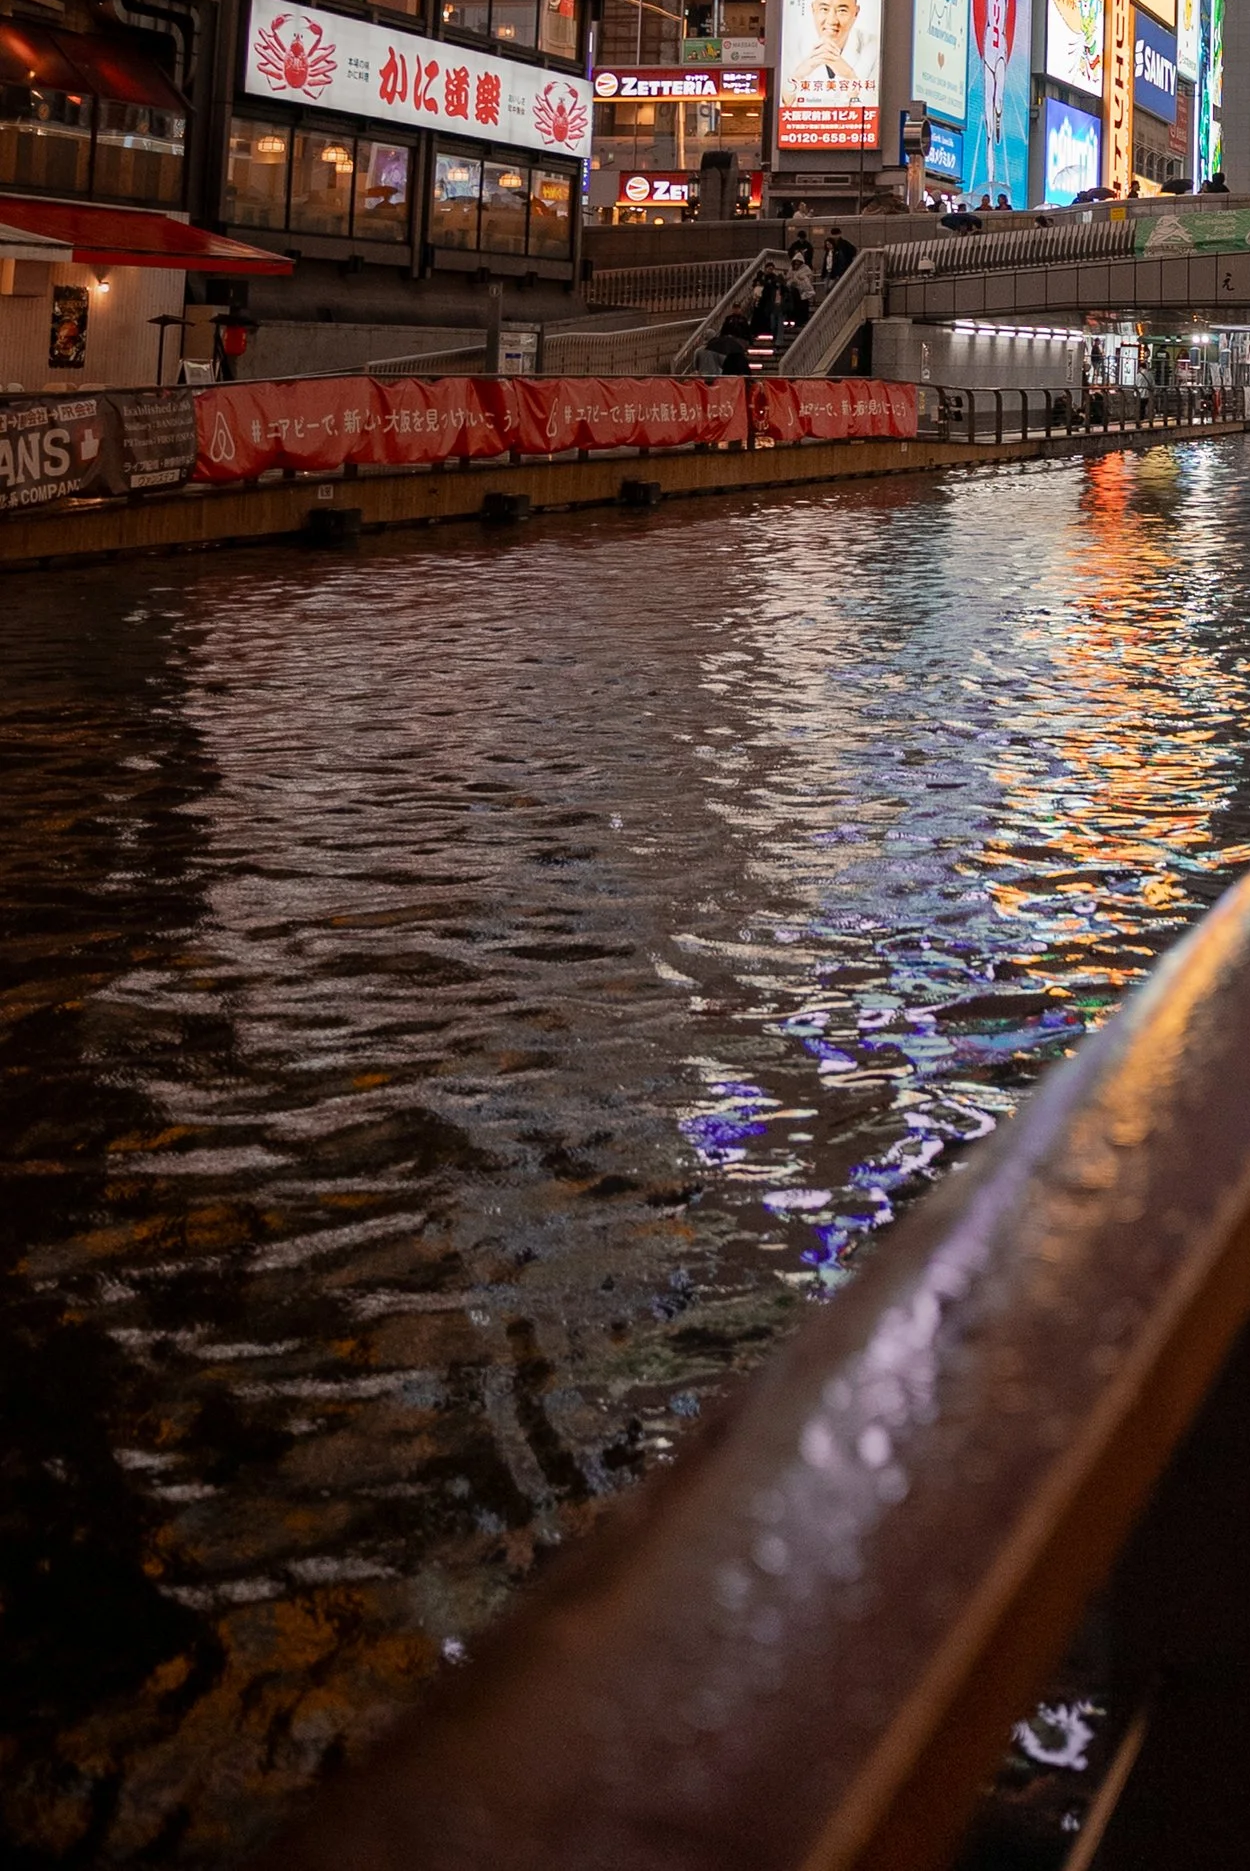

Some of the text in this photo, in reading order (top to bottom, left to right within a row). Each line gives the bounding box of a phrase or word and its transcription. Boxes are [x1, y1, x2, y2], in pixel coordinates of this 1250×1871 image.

[1143, 45, 1177, 96] SAMTY
[621, 77, 718, 96] ZETTERIA
[800, 80, 876, 92] 東京美容外科
